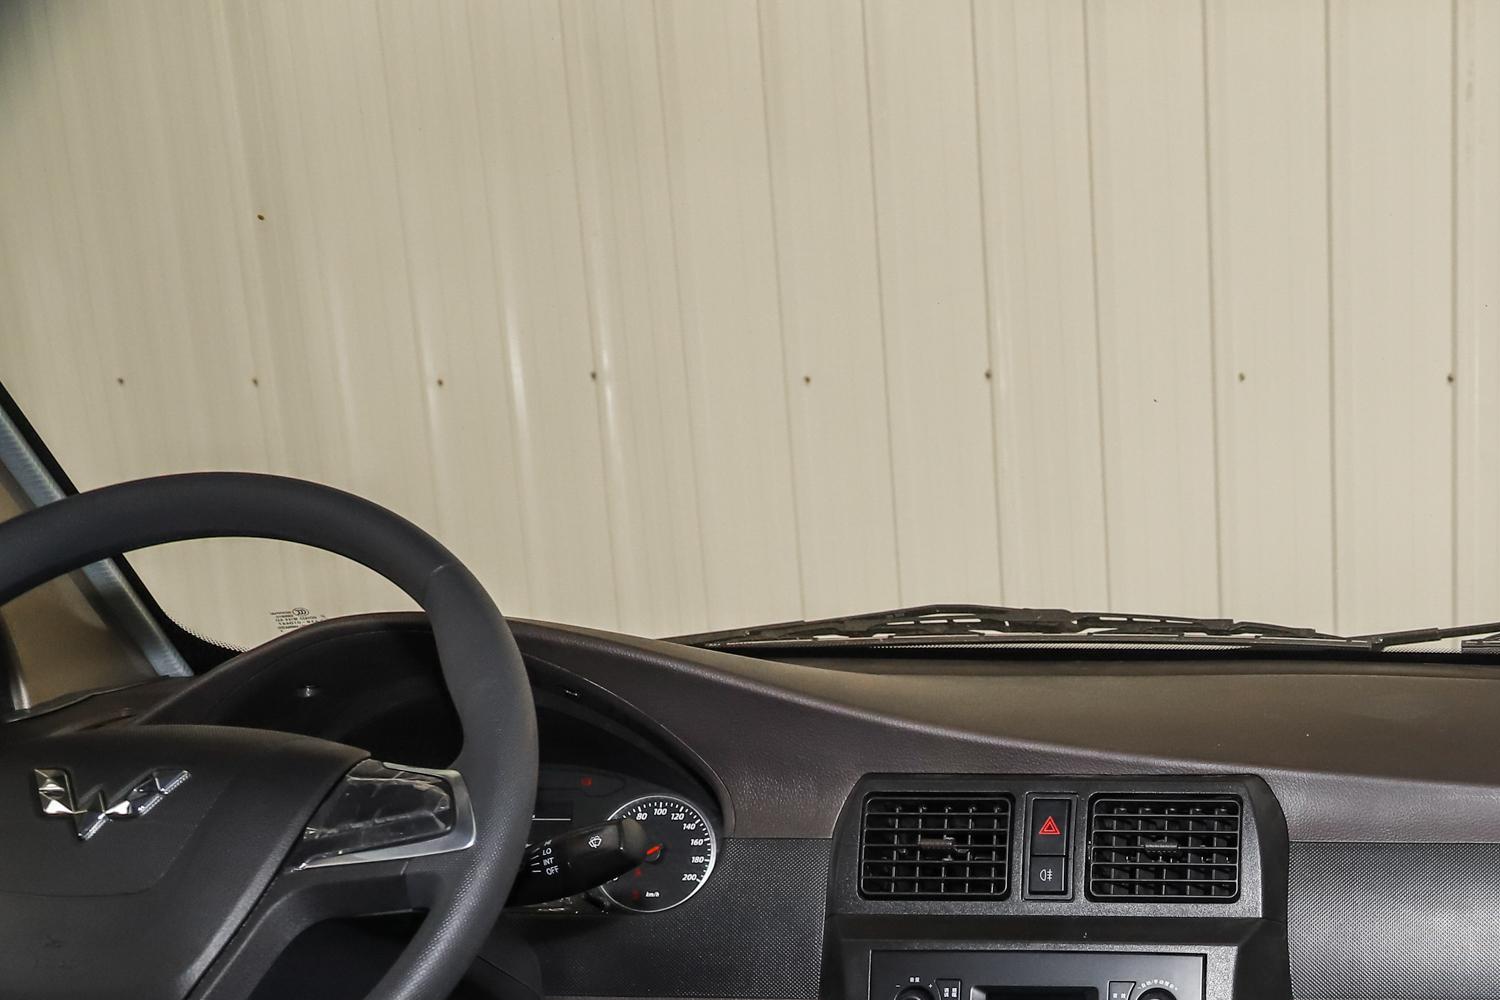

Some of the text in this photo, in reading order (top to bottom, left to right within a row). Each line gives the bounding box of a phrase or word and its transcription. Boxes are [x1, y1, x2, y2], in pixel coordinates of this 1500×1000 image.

[653, 808, 668, 816] 100
[635, 812, 648, 821] 80
[670, 813, 685, 821] 120
[690, 838, 704, 846] 160
[542, 847, 552, 856] LO
[542, 857, 554, 866] INT
[691, 856, 705, 864] 180
[545, 865, 560, 876] OFF
[681, 873, 697, 881] 200
